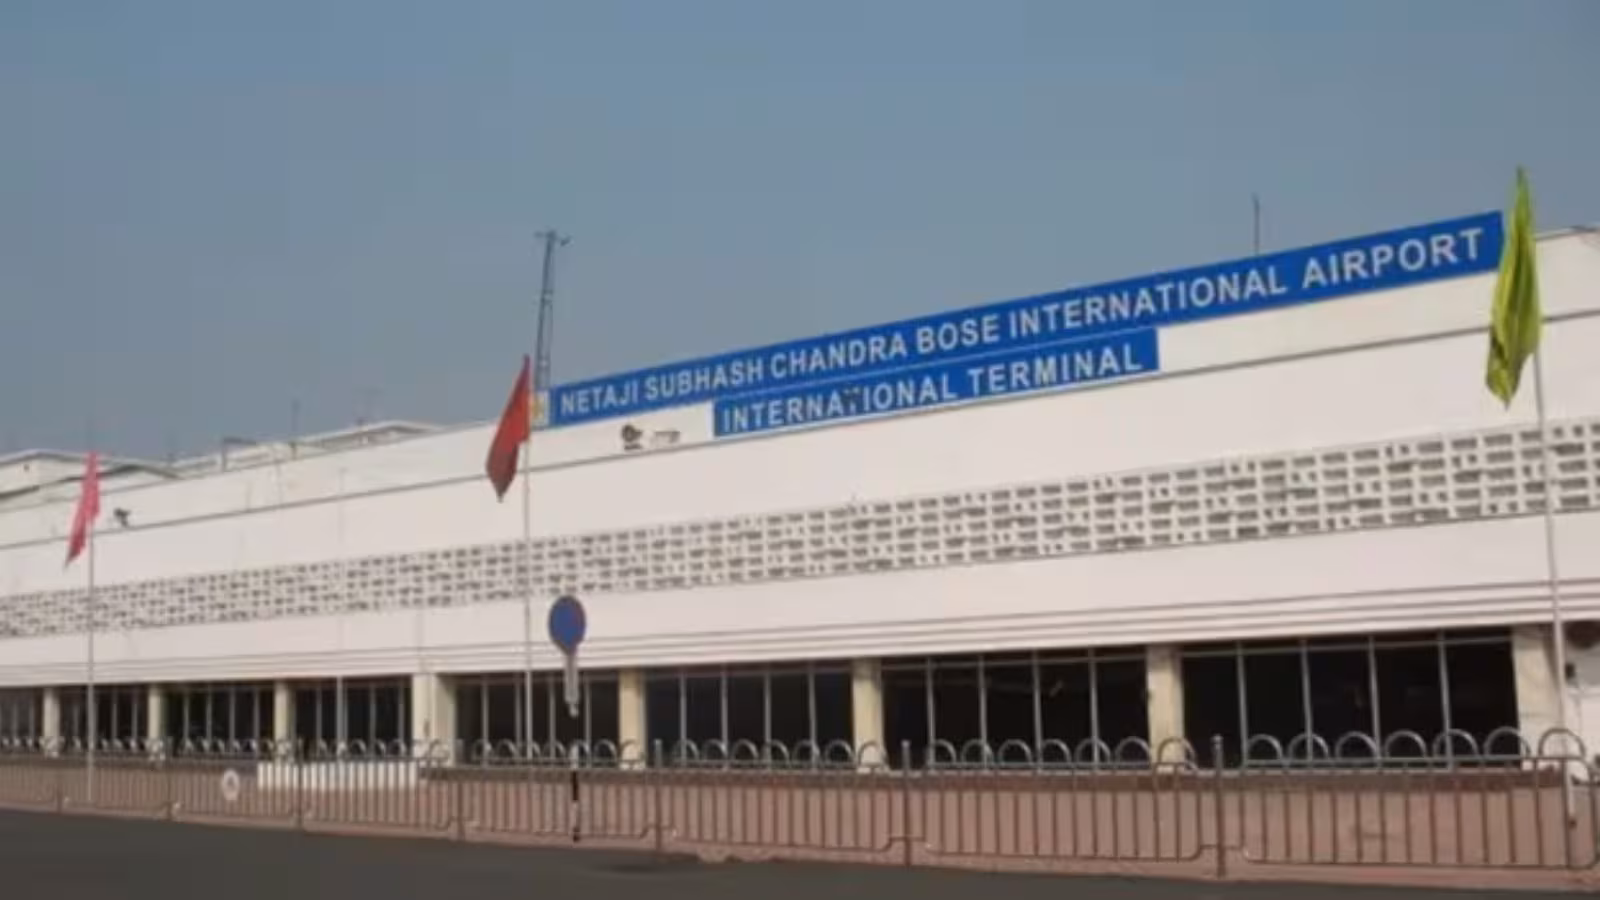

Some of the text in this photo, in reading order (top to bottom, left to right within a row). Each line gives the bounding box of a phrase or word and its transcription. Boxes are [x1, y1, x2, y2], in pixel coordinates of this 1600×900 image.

[561, 227, 1483, 415] NETAJI SUBHASH CHANDRA BOSE INTERNATIONAL AIRPORT
[969, 344, 1142, 394] TERMINAL
